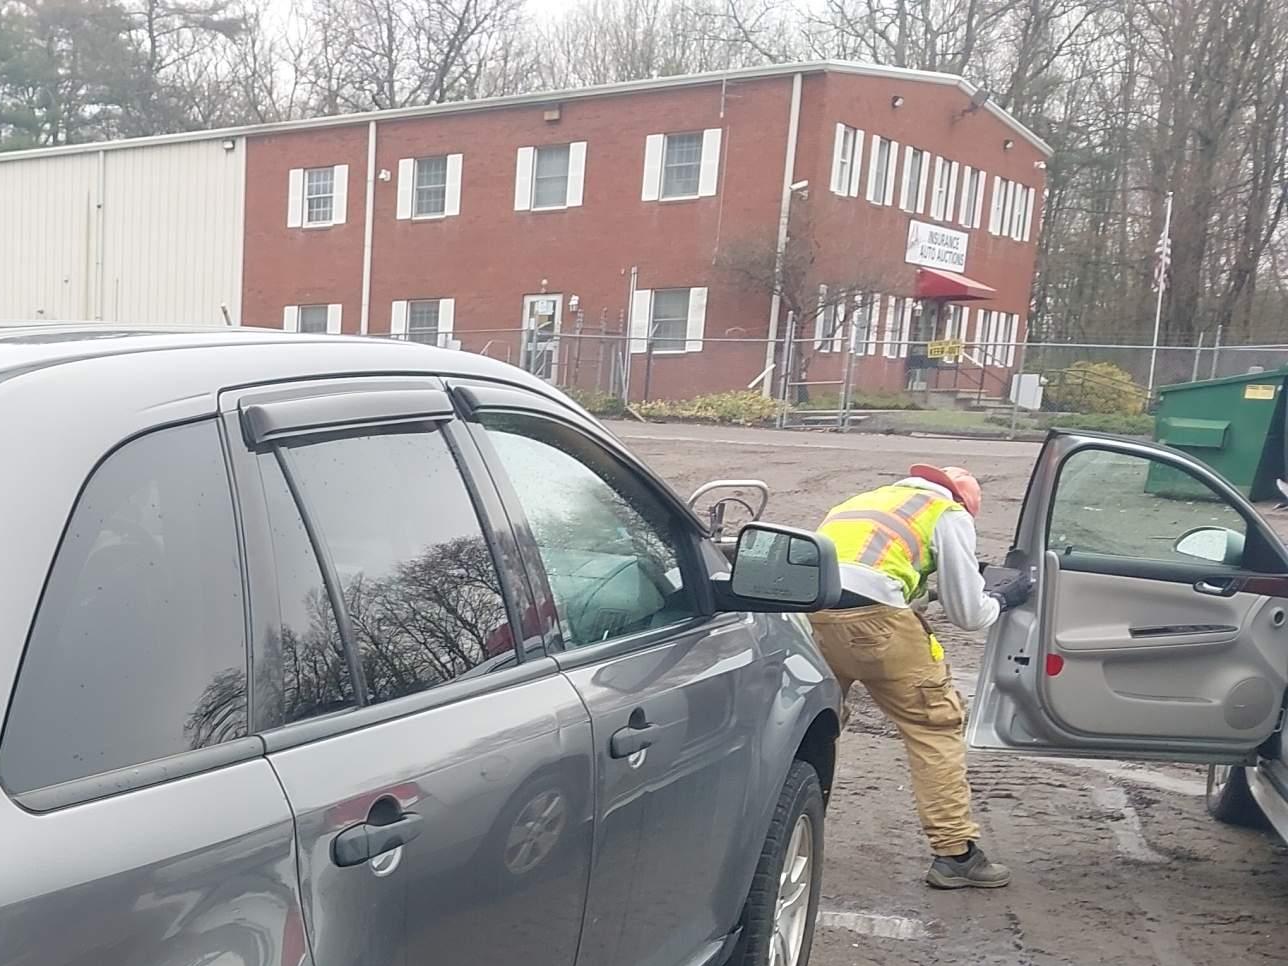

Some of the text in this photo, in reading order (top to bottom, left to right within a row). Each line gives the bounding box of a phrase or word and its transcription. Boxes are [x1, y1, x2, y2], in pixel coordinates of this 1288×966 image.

[927, 230, 961, 250] INSURANCE
[919, 244, 965, 266] AUTO AUCTIONS
